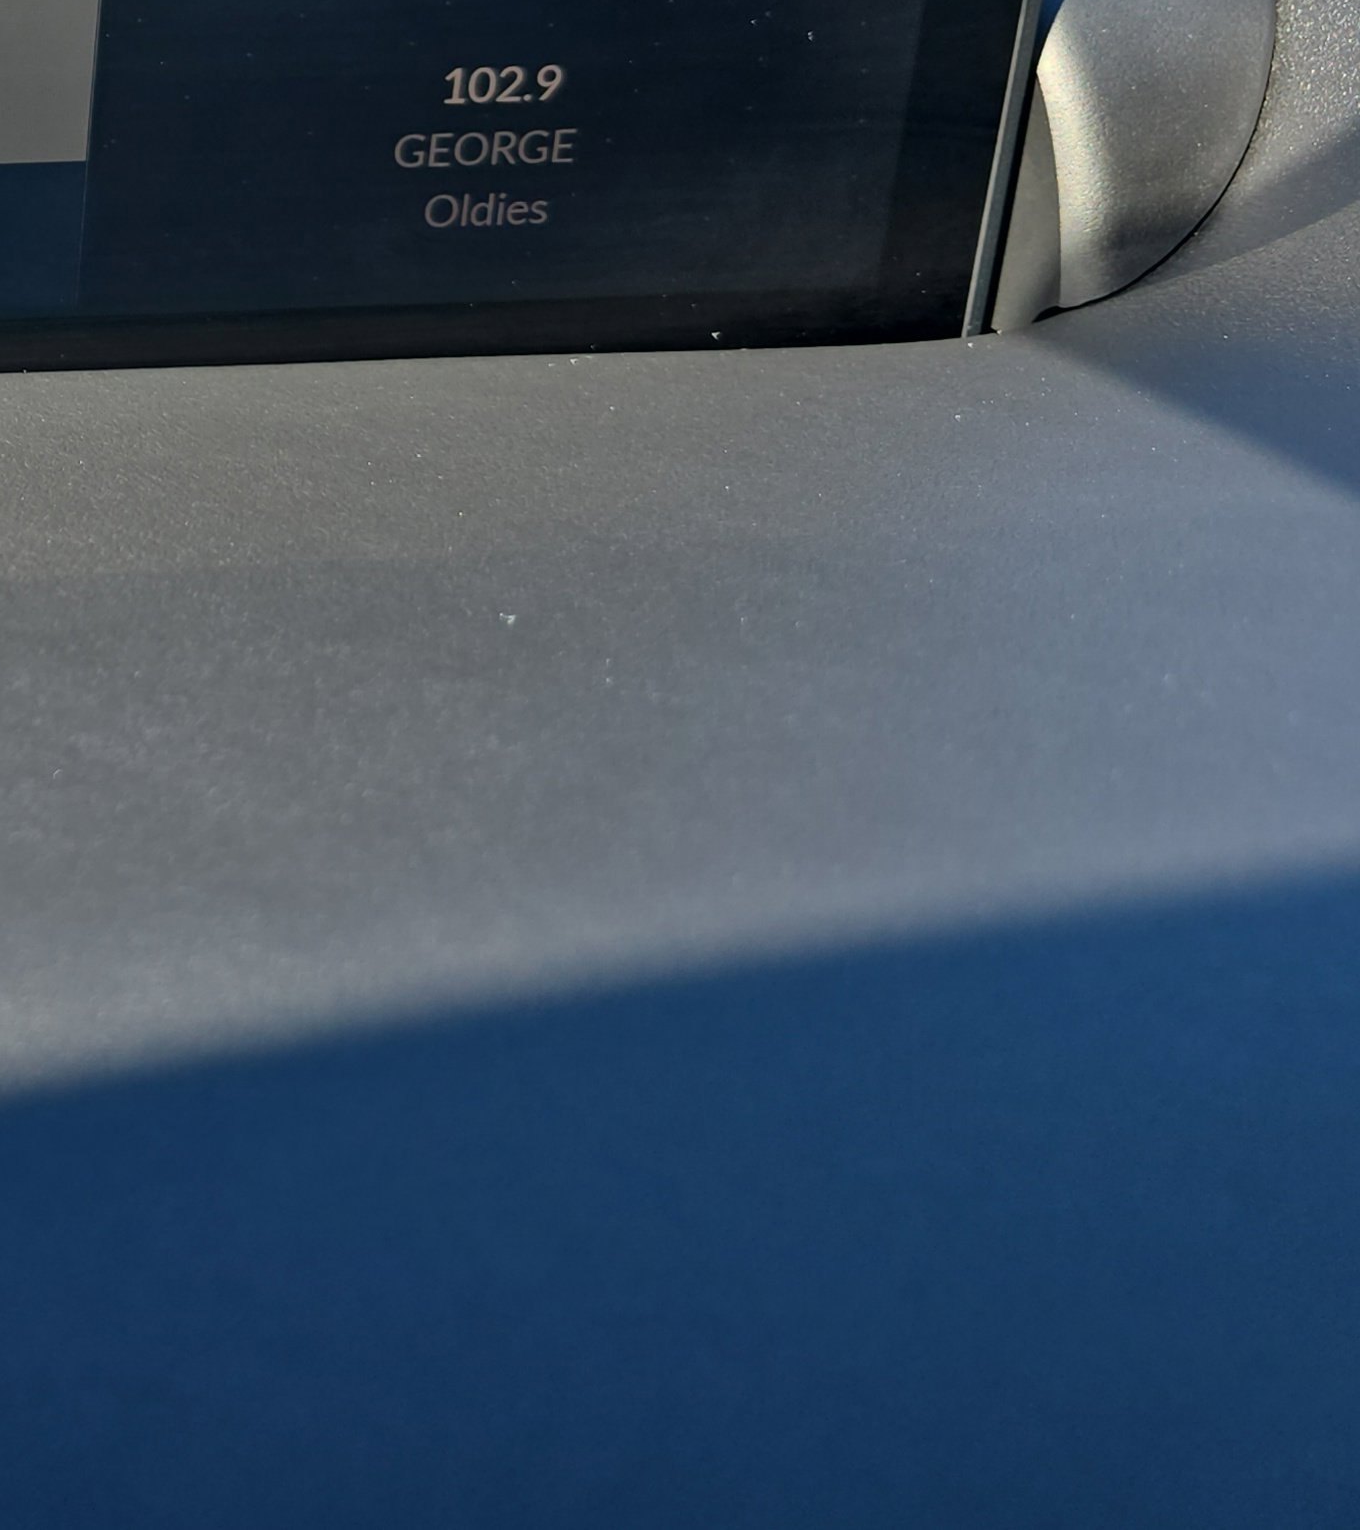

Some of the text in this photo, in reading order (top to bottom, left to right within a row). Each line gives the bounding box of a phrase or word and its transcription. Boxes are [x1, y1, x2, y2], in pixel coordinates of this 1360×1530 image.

[443, 64, 563, 105] 102.9
[394, 128, 578, 168] GEORGE
[424, 192, 549, 228] Oldies
